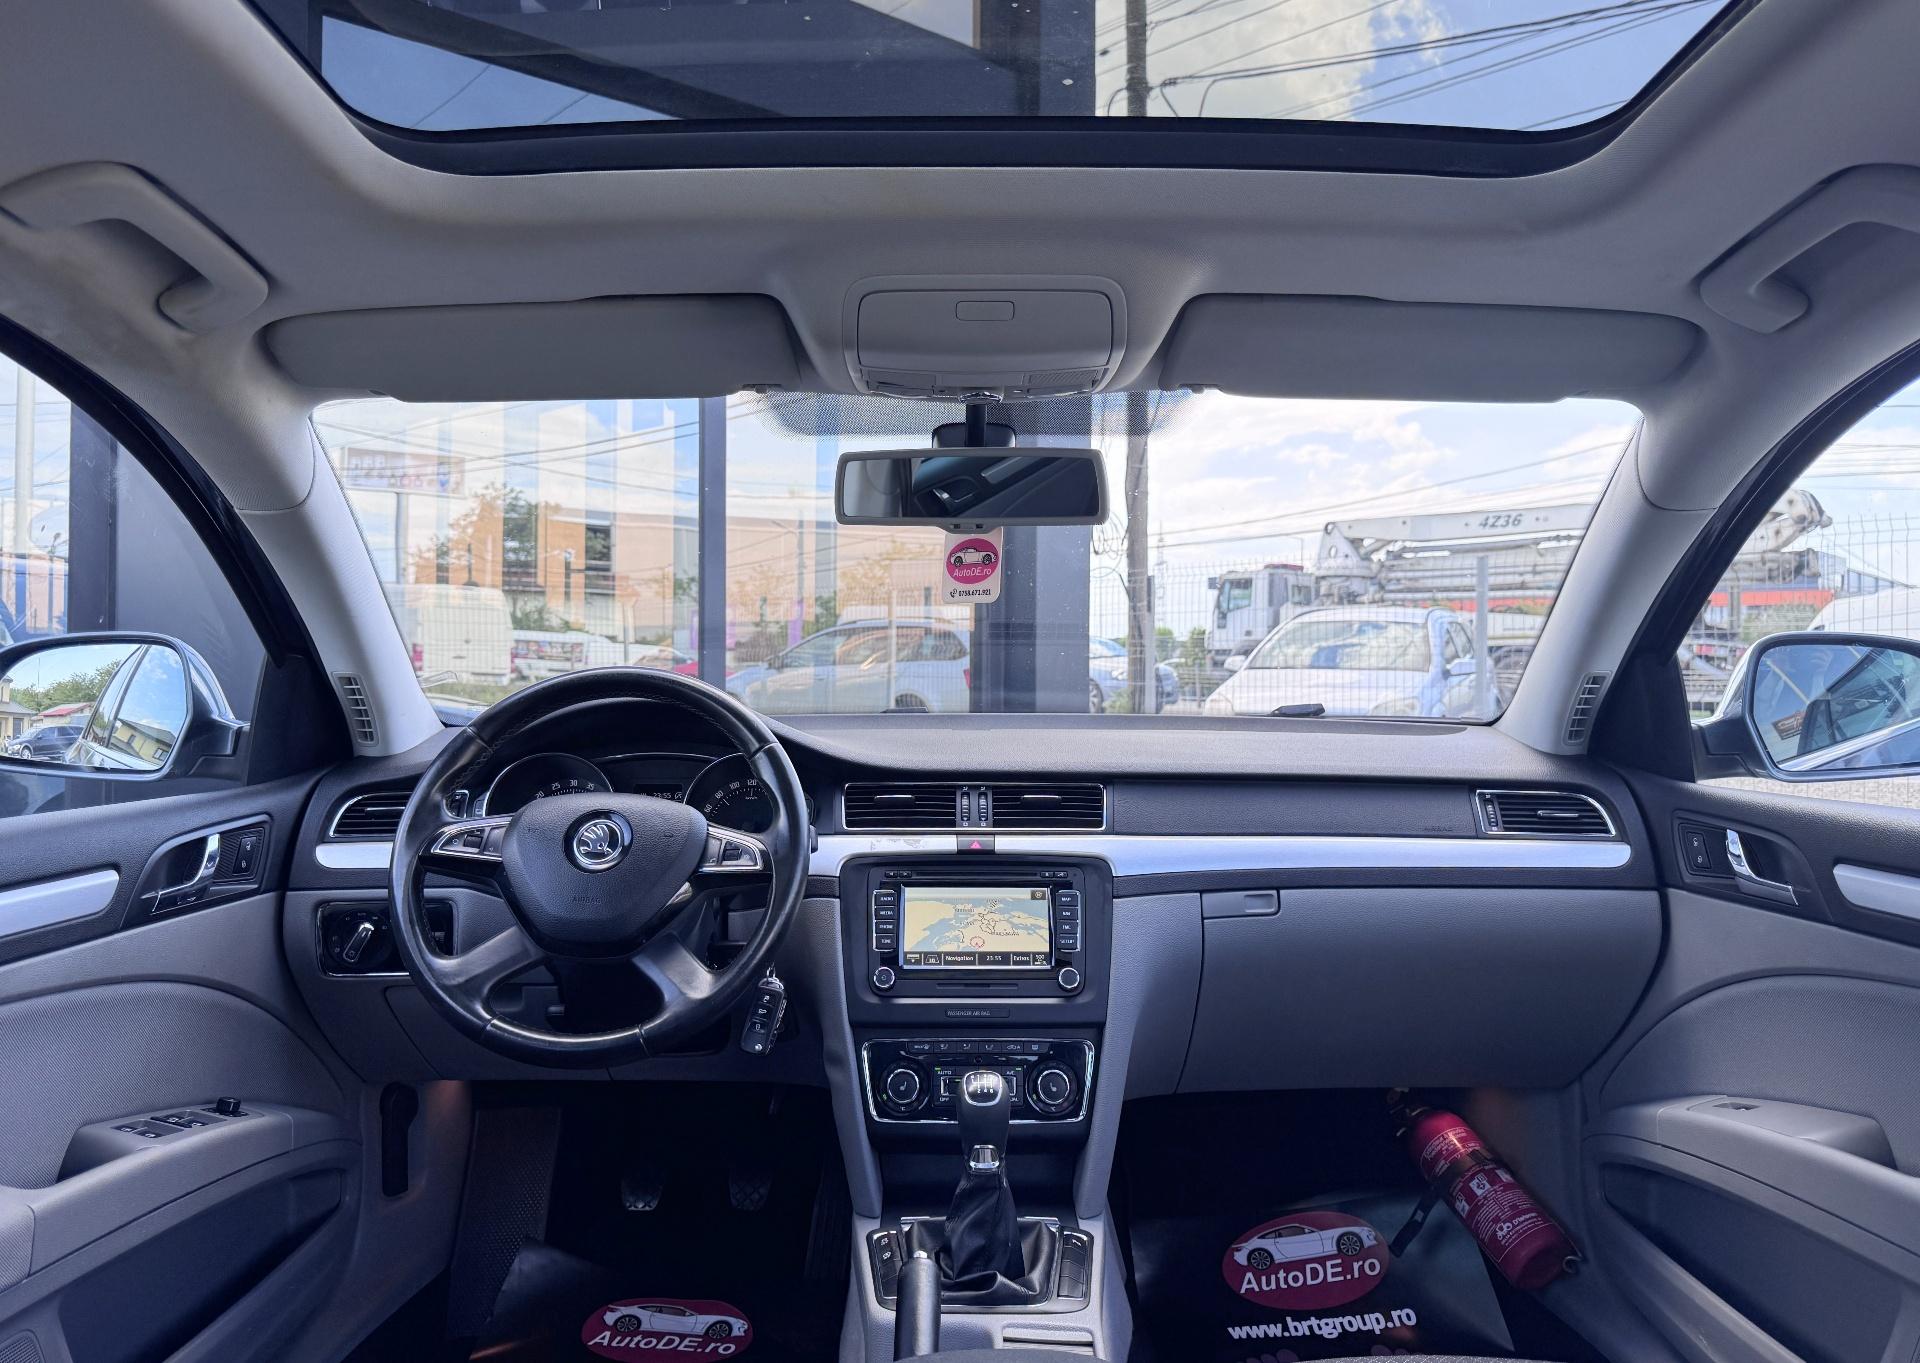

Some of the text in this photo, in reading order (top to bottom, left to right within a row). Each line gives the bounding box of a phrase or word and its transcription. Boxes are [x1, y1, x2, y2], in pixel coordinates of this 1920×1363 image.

[1479, 513, 1523, 528] 4Z36
[953, 567, 992, 577] AutoDE.ro
[552, 782, 560, 790] 25
[569, 779, 578, 787] 30
[1239, 1257, 1382, 1294] AutoDE.ro
[1227, 1307, 1418, 1340] www.brtgroup.ro
[587, 1330, 737, 1356] AutoDE.ro
